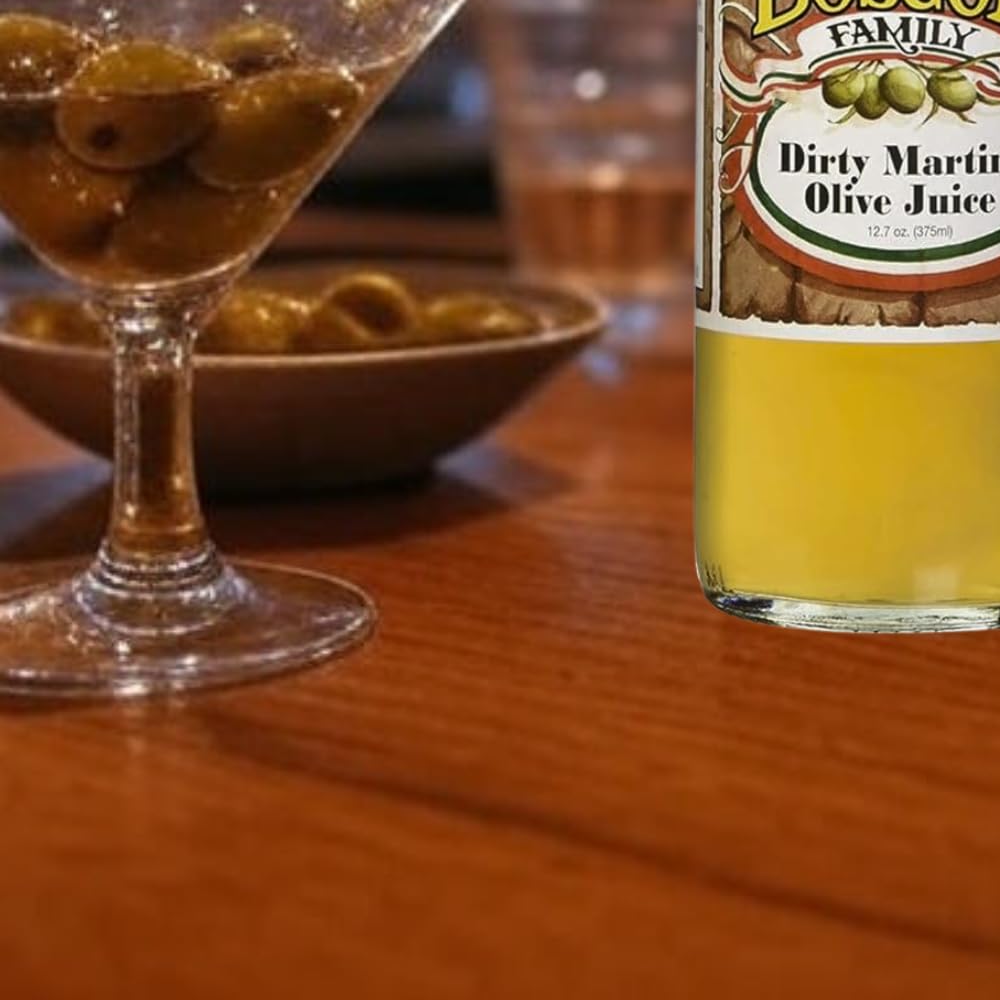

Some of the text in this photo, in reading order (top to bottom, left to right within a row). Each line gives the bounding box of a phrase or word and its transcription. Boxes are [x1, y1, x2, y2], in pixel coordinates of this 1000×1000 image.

[827, 16, 981, 54] FAMILY
[779, 142, 870, 184] Dirty
[805, 181, 996, 216] Olive Juice
[867, 225, 953, 239] 12.7 oz. (375ml)
